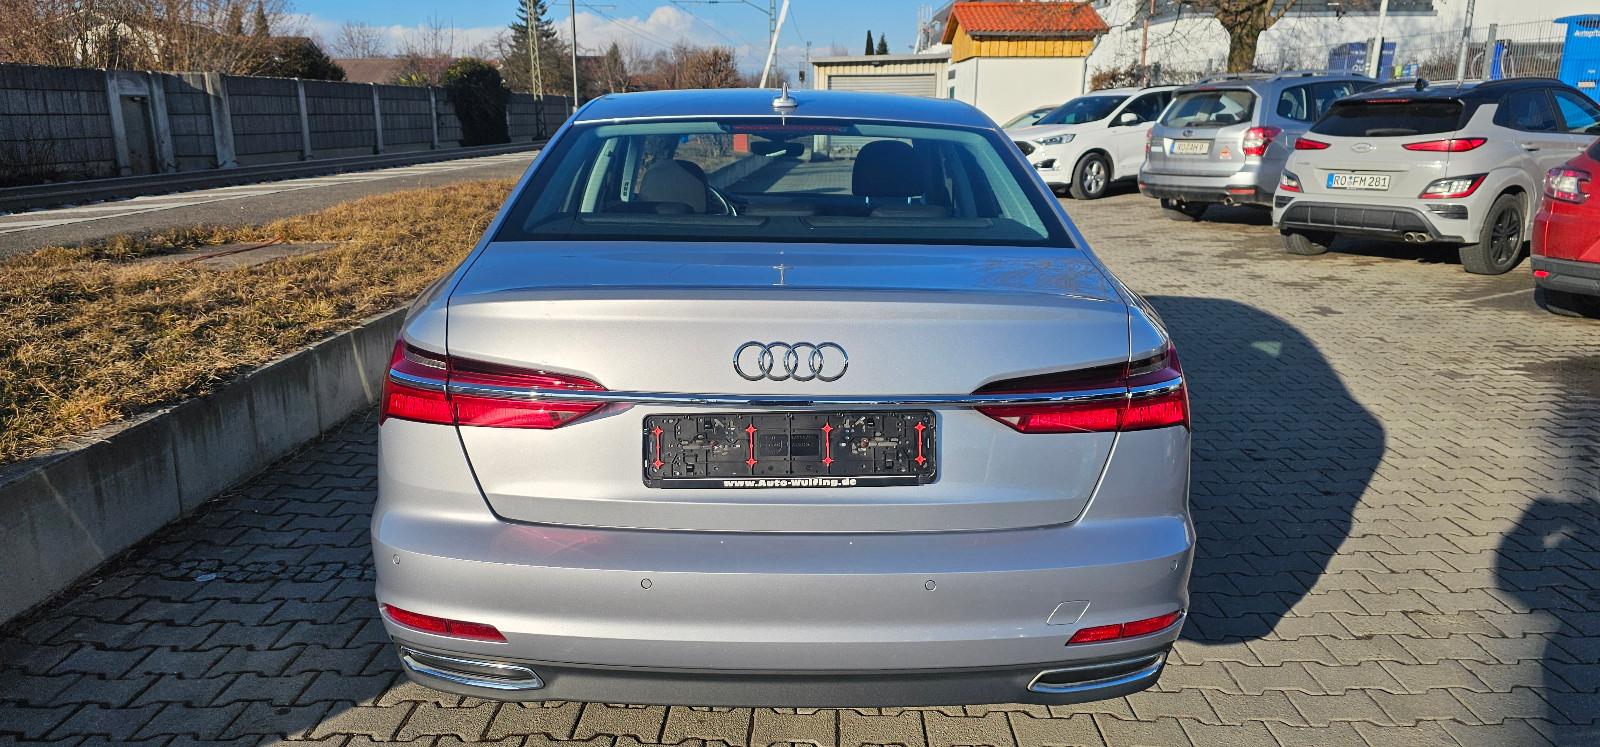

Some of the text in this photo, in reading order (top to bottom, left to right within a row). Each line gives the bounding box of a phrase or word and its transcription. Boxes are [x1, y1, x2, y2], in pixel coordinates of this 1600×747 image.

[1333, 175, 1387, 187] RO FM 281
